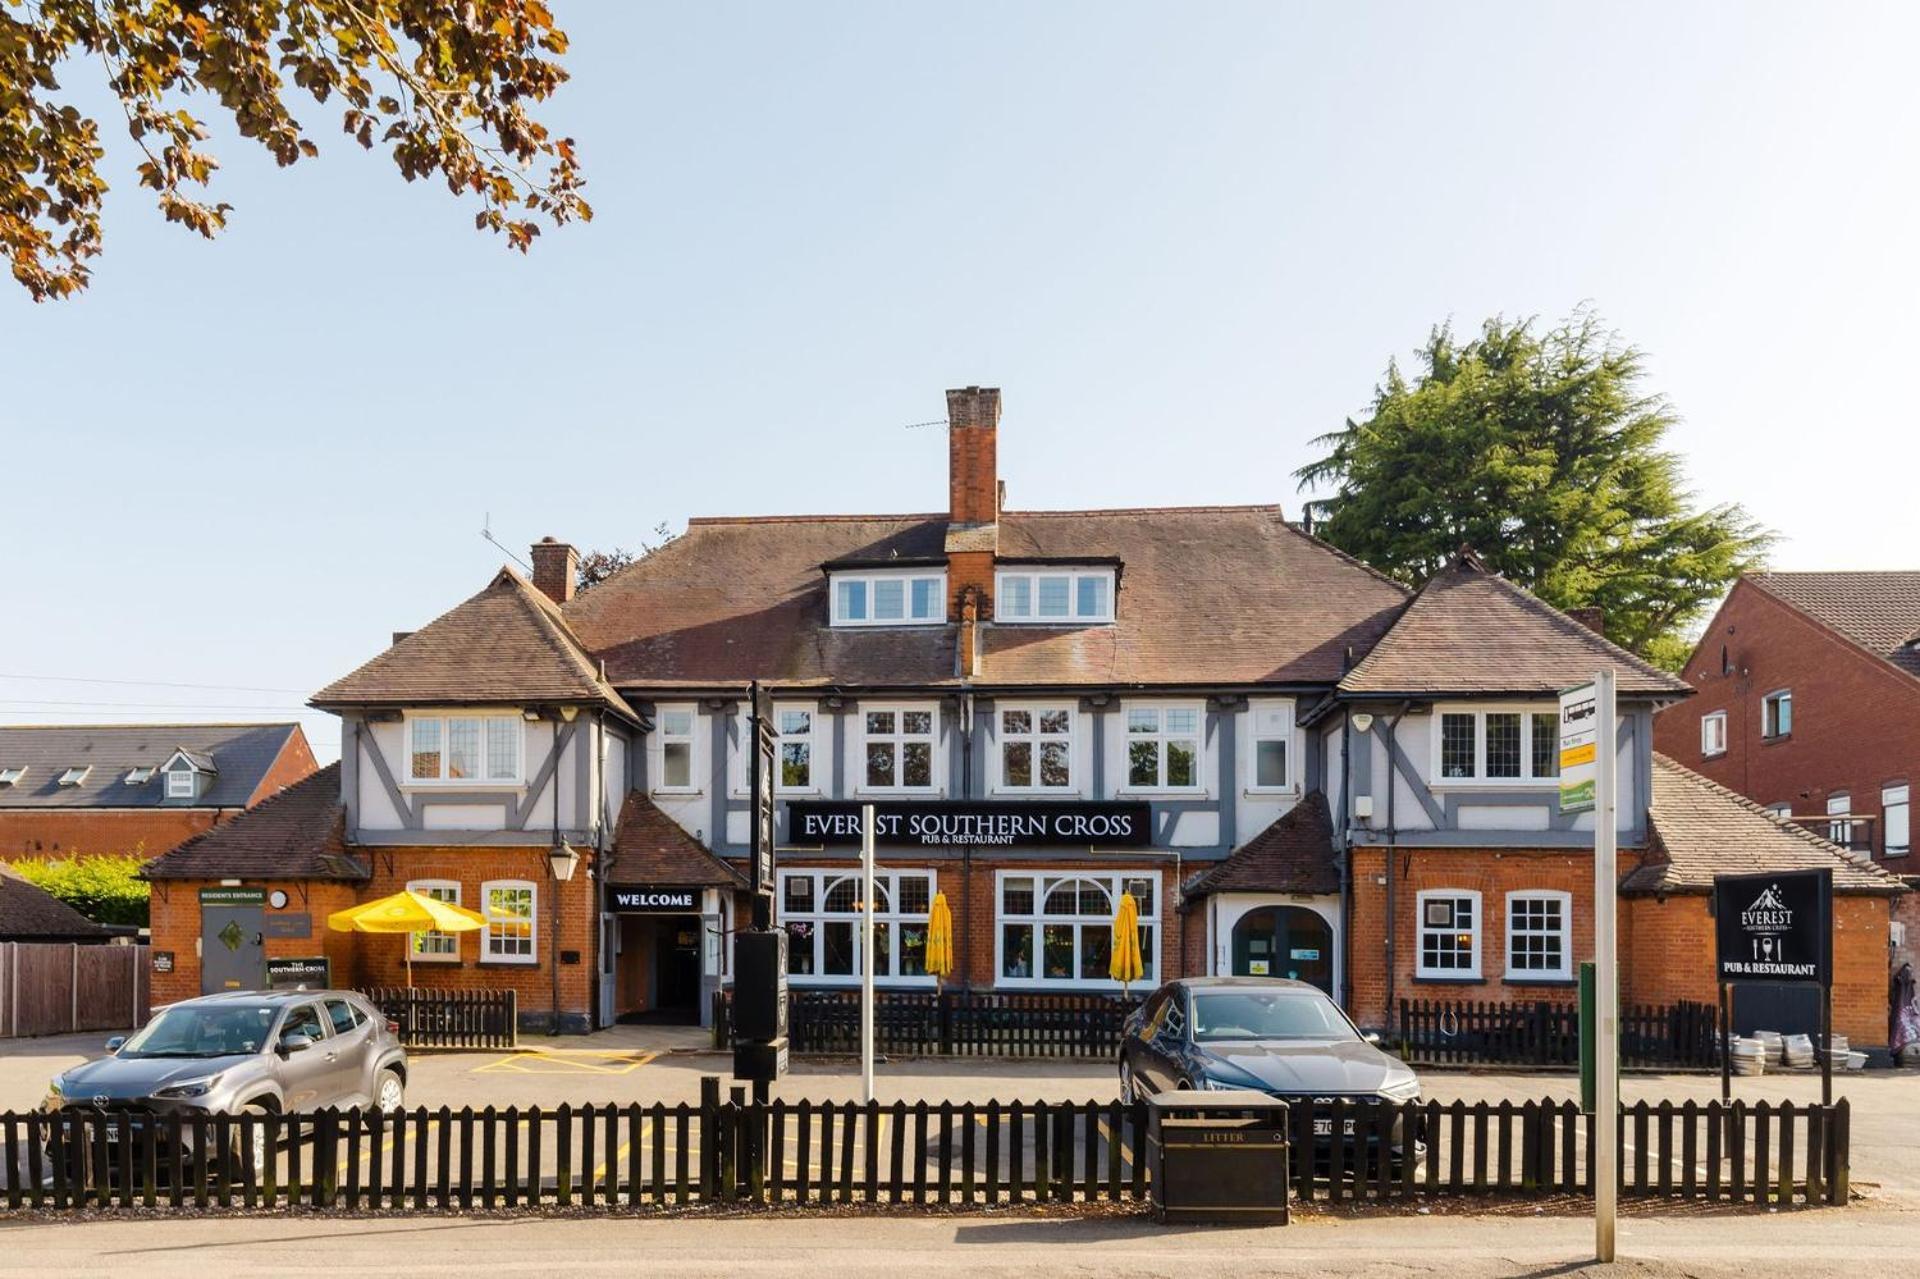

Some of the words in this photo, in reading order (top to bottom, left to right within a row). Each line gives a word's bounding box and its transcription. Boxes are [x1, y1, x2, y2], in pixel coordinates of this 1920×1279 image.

[804, 815, 902, 835] EVERST
[909, 815, 1047, 835] SOUTHERN
[1055, 815, 1132, 836] CROSS
[921, 835, 940, 844] PUB
[942, 835, 950, 844] &
[952, 835, 1015, 845] RESTAURANT
[616, 894, 693, 906] WELCOME
[1741, 910, 1793, 925] EVEREST
[1724, 962, 1743, 973] PUB
[1743, 962, 1752, 973] &
[1752, 963, 1816, 976] RESTAURANT
[1203, 1132, 1245, 1143] LITTER
